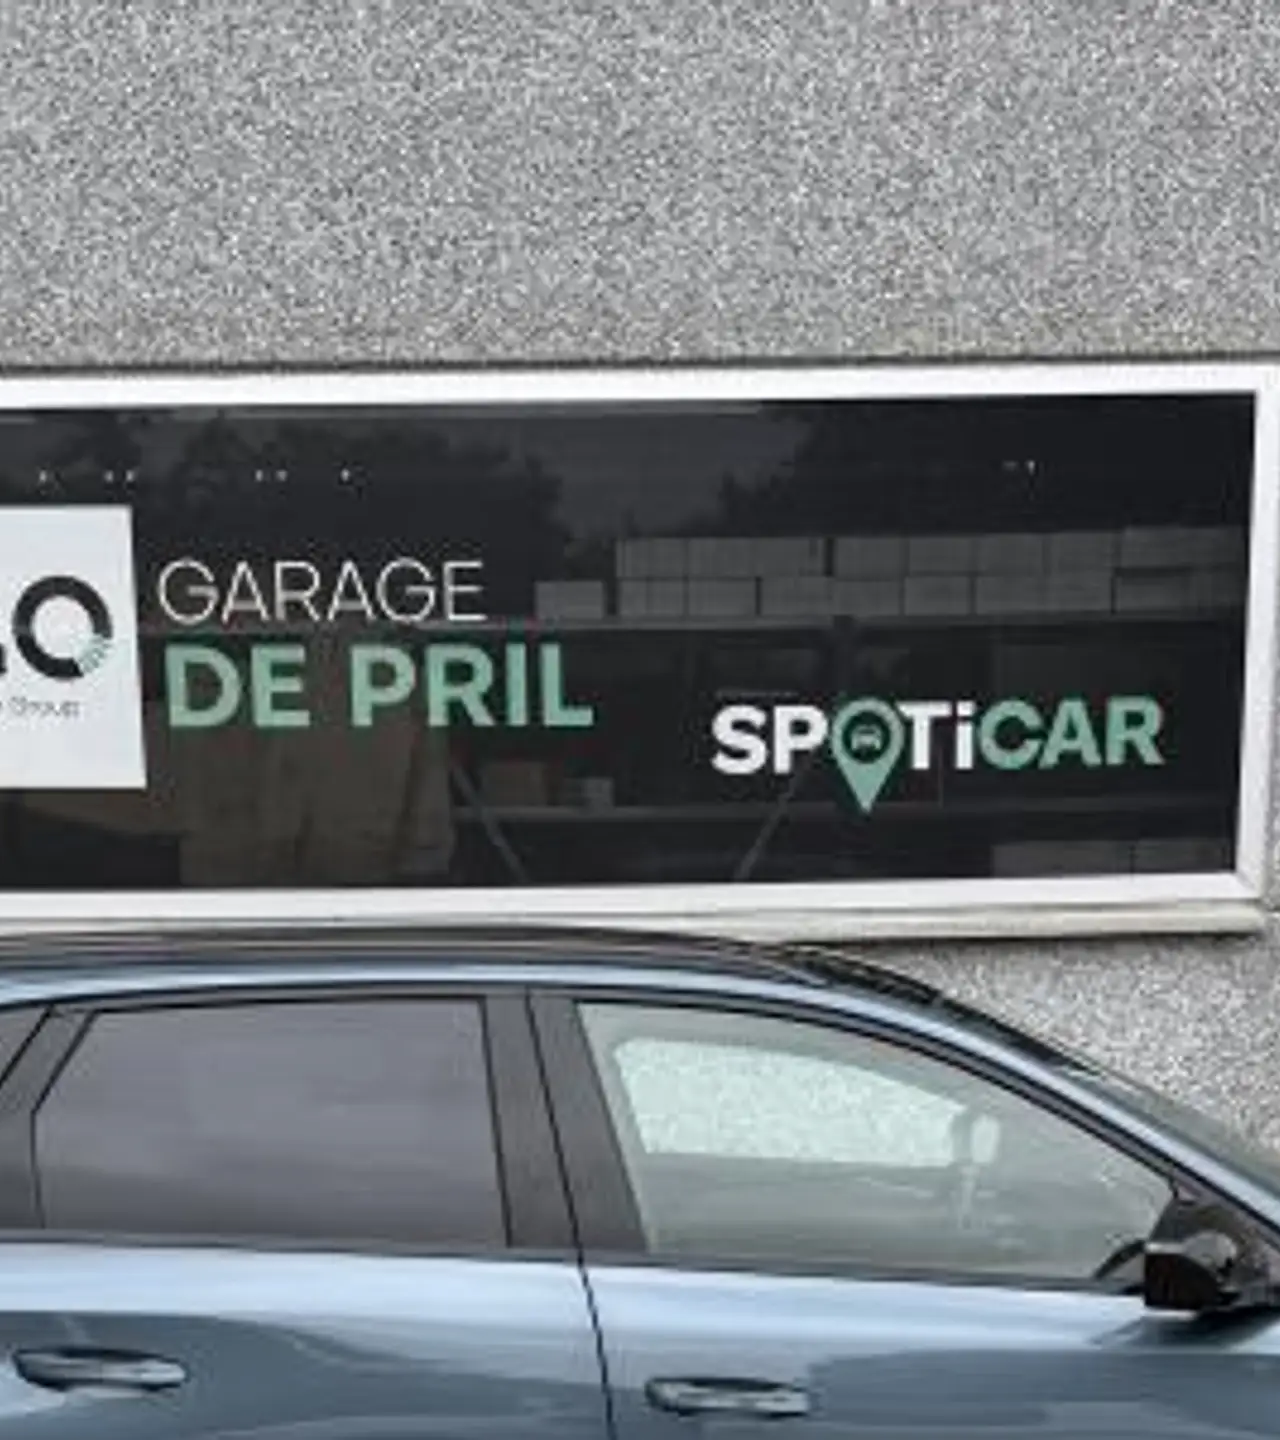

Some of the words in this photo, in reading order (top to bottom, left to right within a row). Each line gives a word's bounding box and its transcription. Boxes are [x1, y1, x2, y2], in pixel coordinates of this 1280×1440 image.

[158, 557, 487, 626] GARAGE
[164, 643, 311, 728] DE
[349, 642, 595, 728] PRIL
